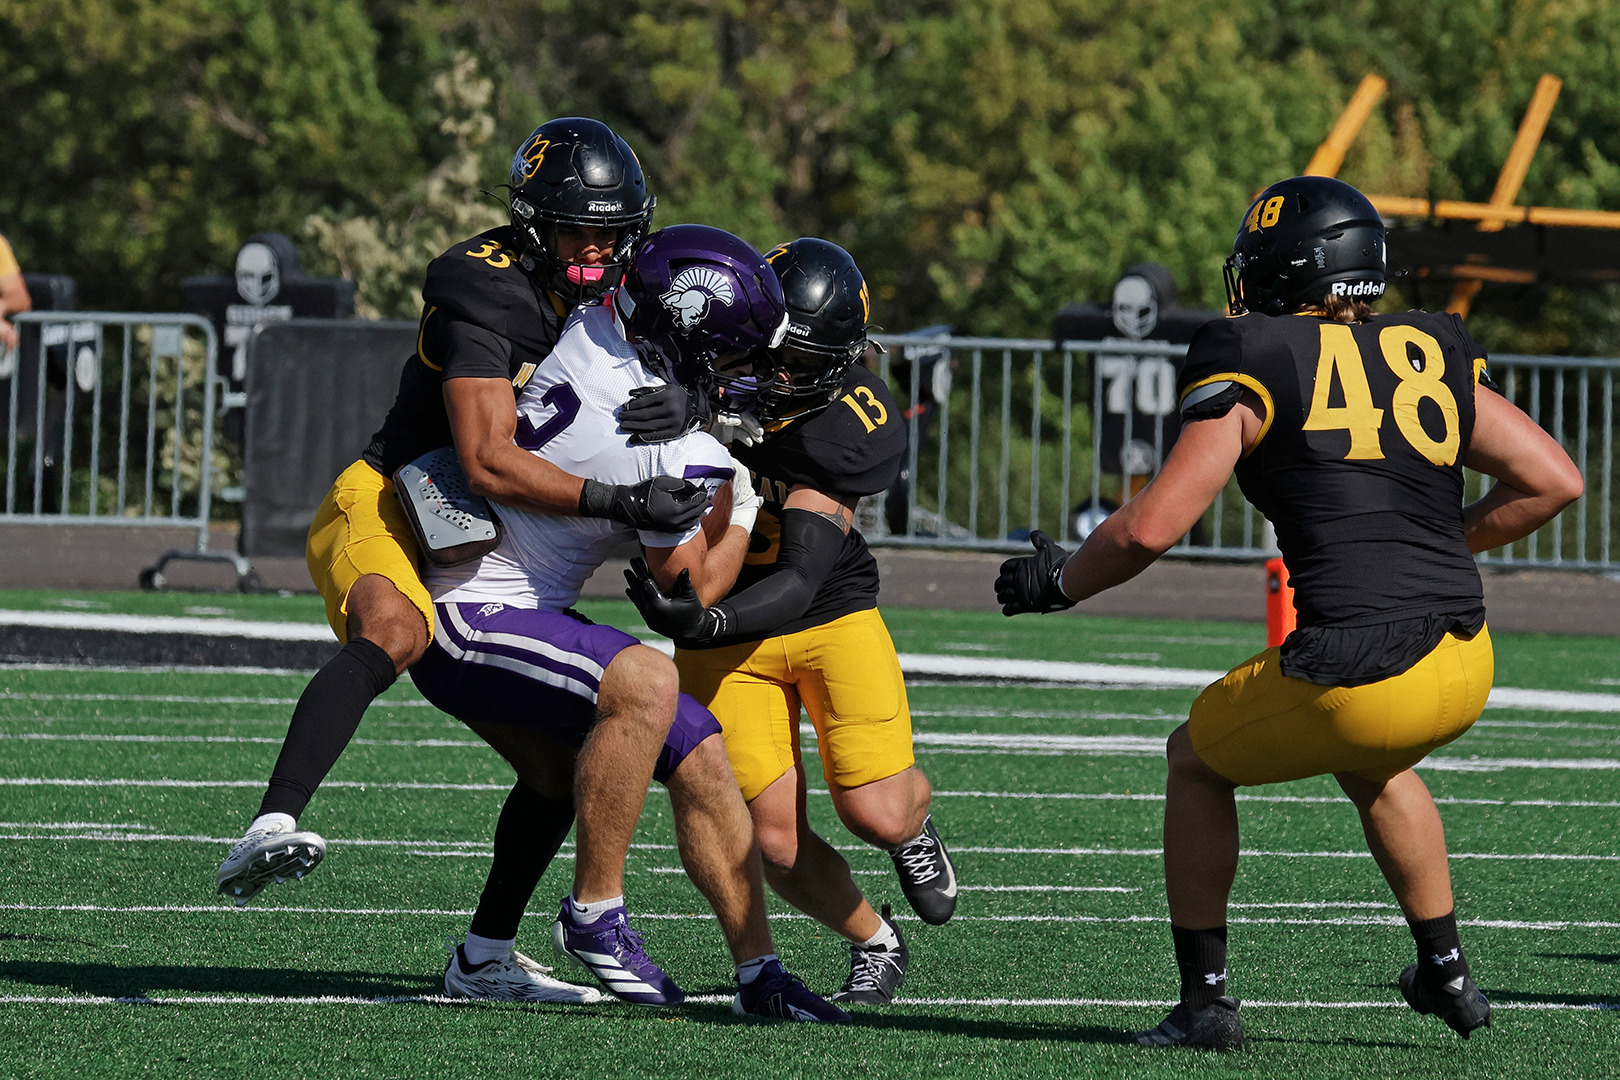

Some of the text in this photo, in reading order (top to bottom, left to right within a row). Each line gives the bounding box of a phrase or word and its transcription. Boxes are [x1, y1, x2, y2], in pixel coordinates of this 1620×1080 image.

[1245, 195, 1285, 233] 48
[1331, 280, 1386, 297] Riddell
[786, 322, 810, 337] ddell
[1101, 356, 1176, 416] 70
[1302, 323, 1461, 467] 48
[840, 385, 888, 434] 13
